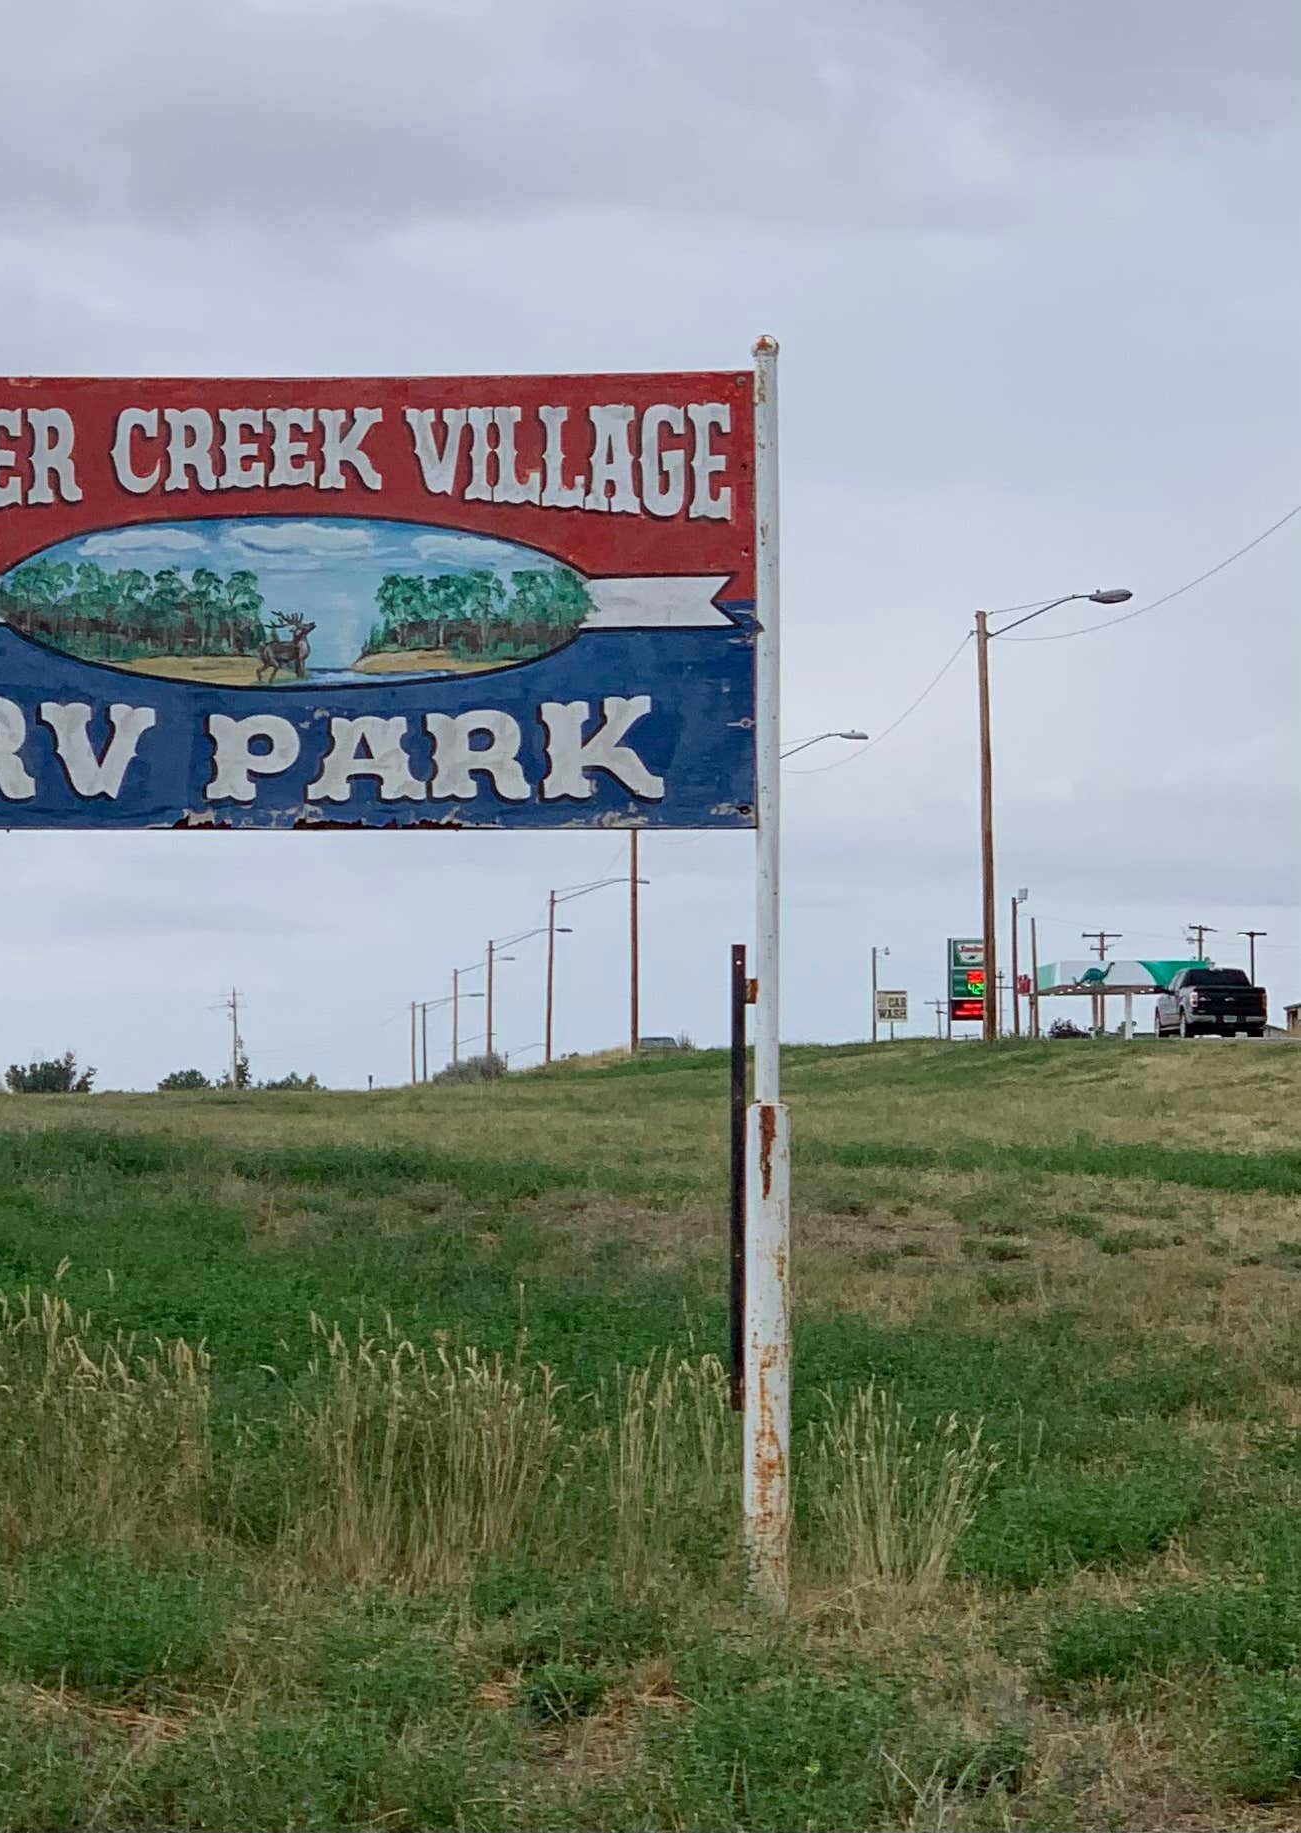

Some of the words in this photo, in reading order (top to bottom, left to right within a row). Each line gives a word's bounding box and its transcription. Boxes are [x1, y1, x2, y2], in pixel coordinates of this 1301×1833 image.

[110, 405, 383, 494] CREEK
[404, 402, 733, 521] VILLAGE
[206, 694, 665, 803] PARK
[877, 1009, 907, 1019] WASH
[888, 997, 907, 1008] CAR
